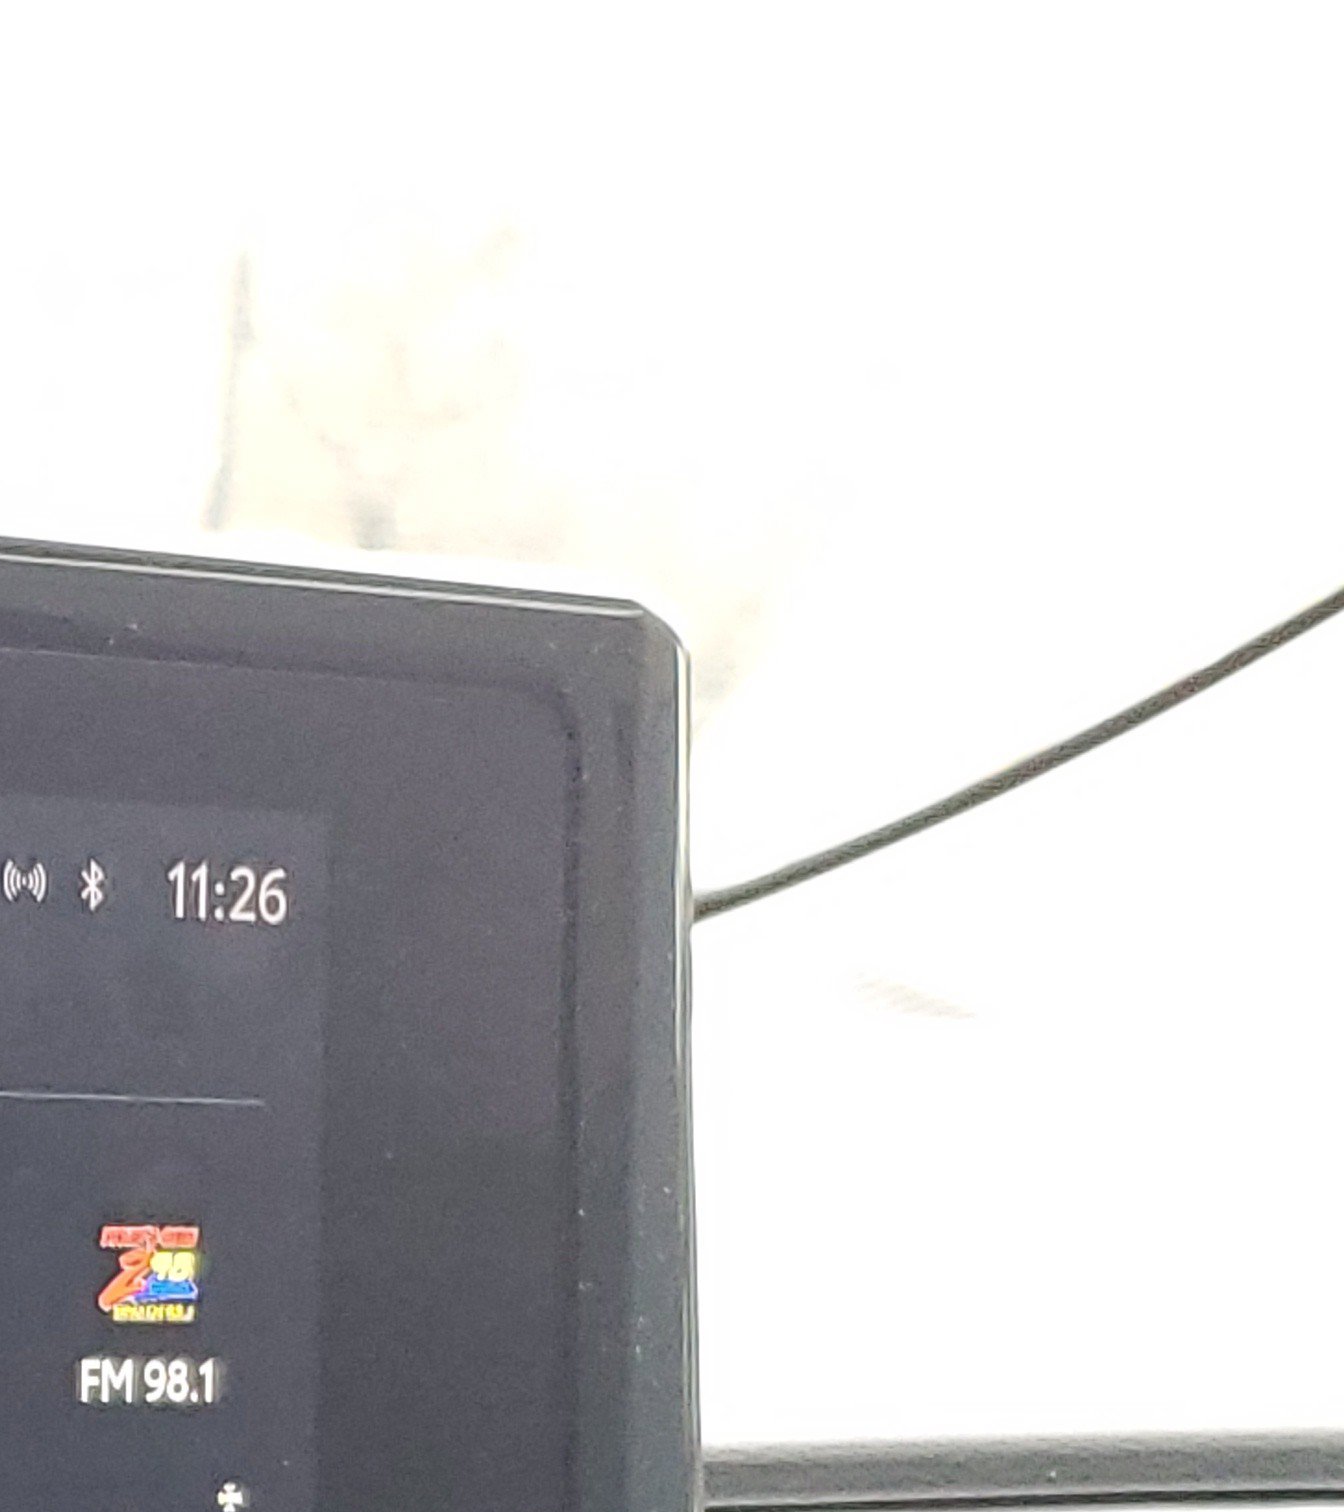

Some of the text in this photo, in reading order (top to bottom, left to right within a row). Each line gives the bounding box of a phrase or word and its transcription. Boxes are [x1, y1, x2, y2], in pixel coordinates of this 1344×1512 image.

[167, 861, 288, 925] 11:26
[79, 1357, 216, 1405] FM 98.1
